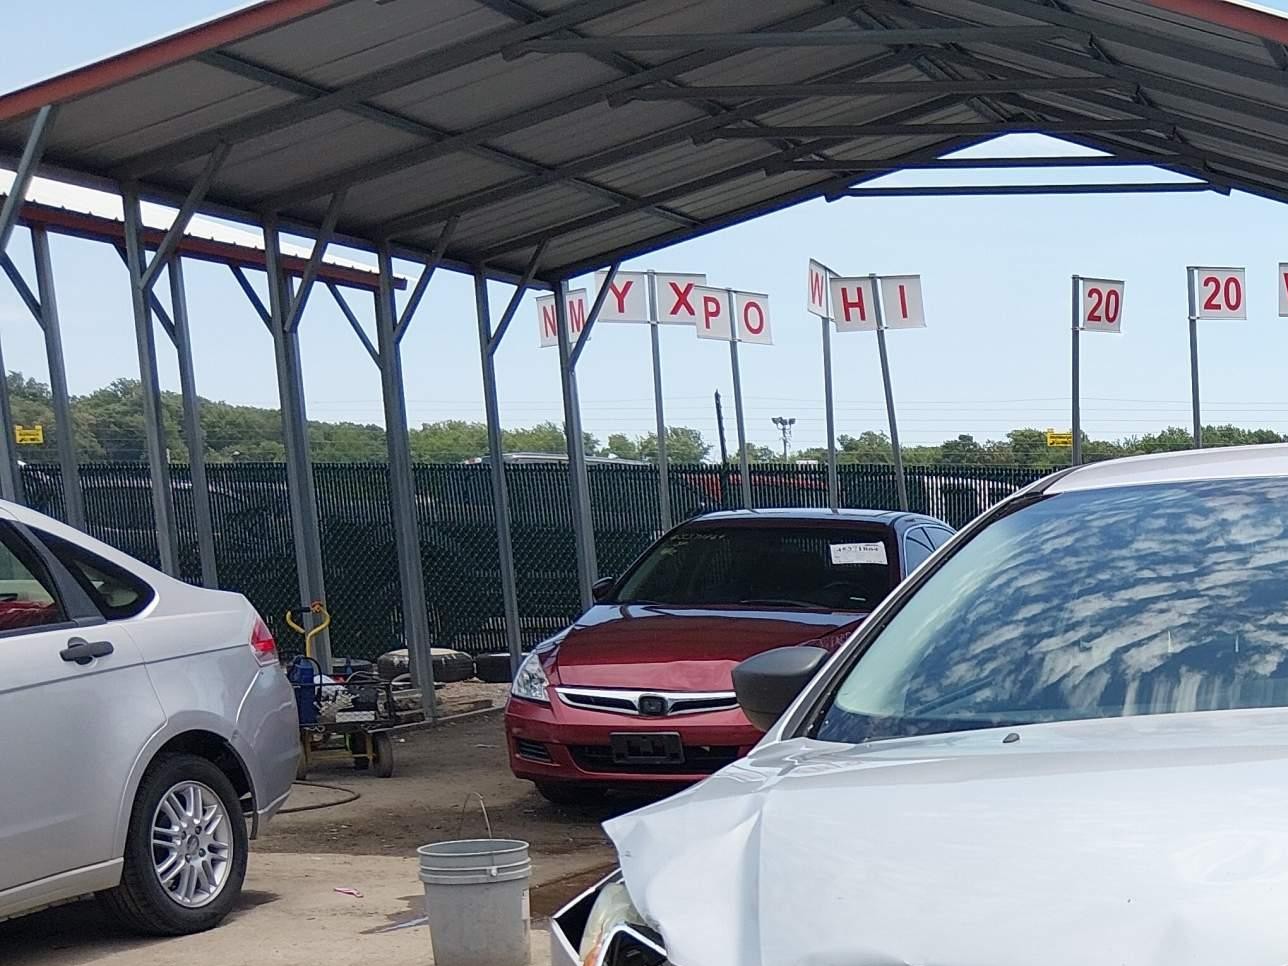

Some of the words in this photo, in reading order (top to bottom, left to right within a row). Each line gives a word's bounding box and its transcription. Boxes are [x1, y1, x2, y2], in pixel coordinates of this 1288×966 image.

[609, 281, 632, 313] Y
[669, 282, 695, 316] X
[810, 270, 825, 308] W
[841, 287, 866, 321] H
[898, 284, 908, 319] I
[1087, 287, 1120, 323] 20
[1203, 276, 1243, 311] 20
[703, 295, 721, 329] P
